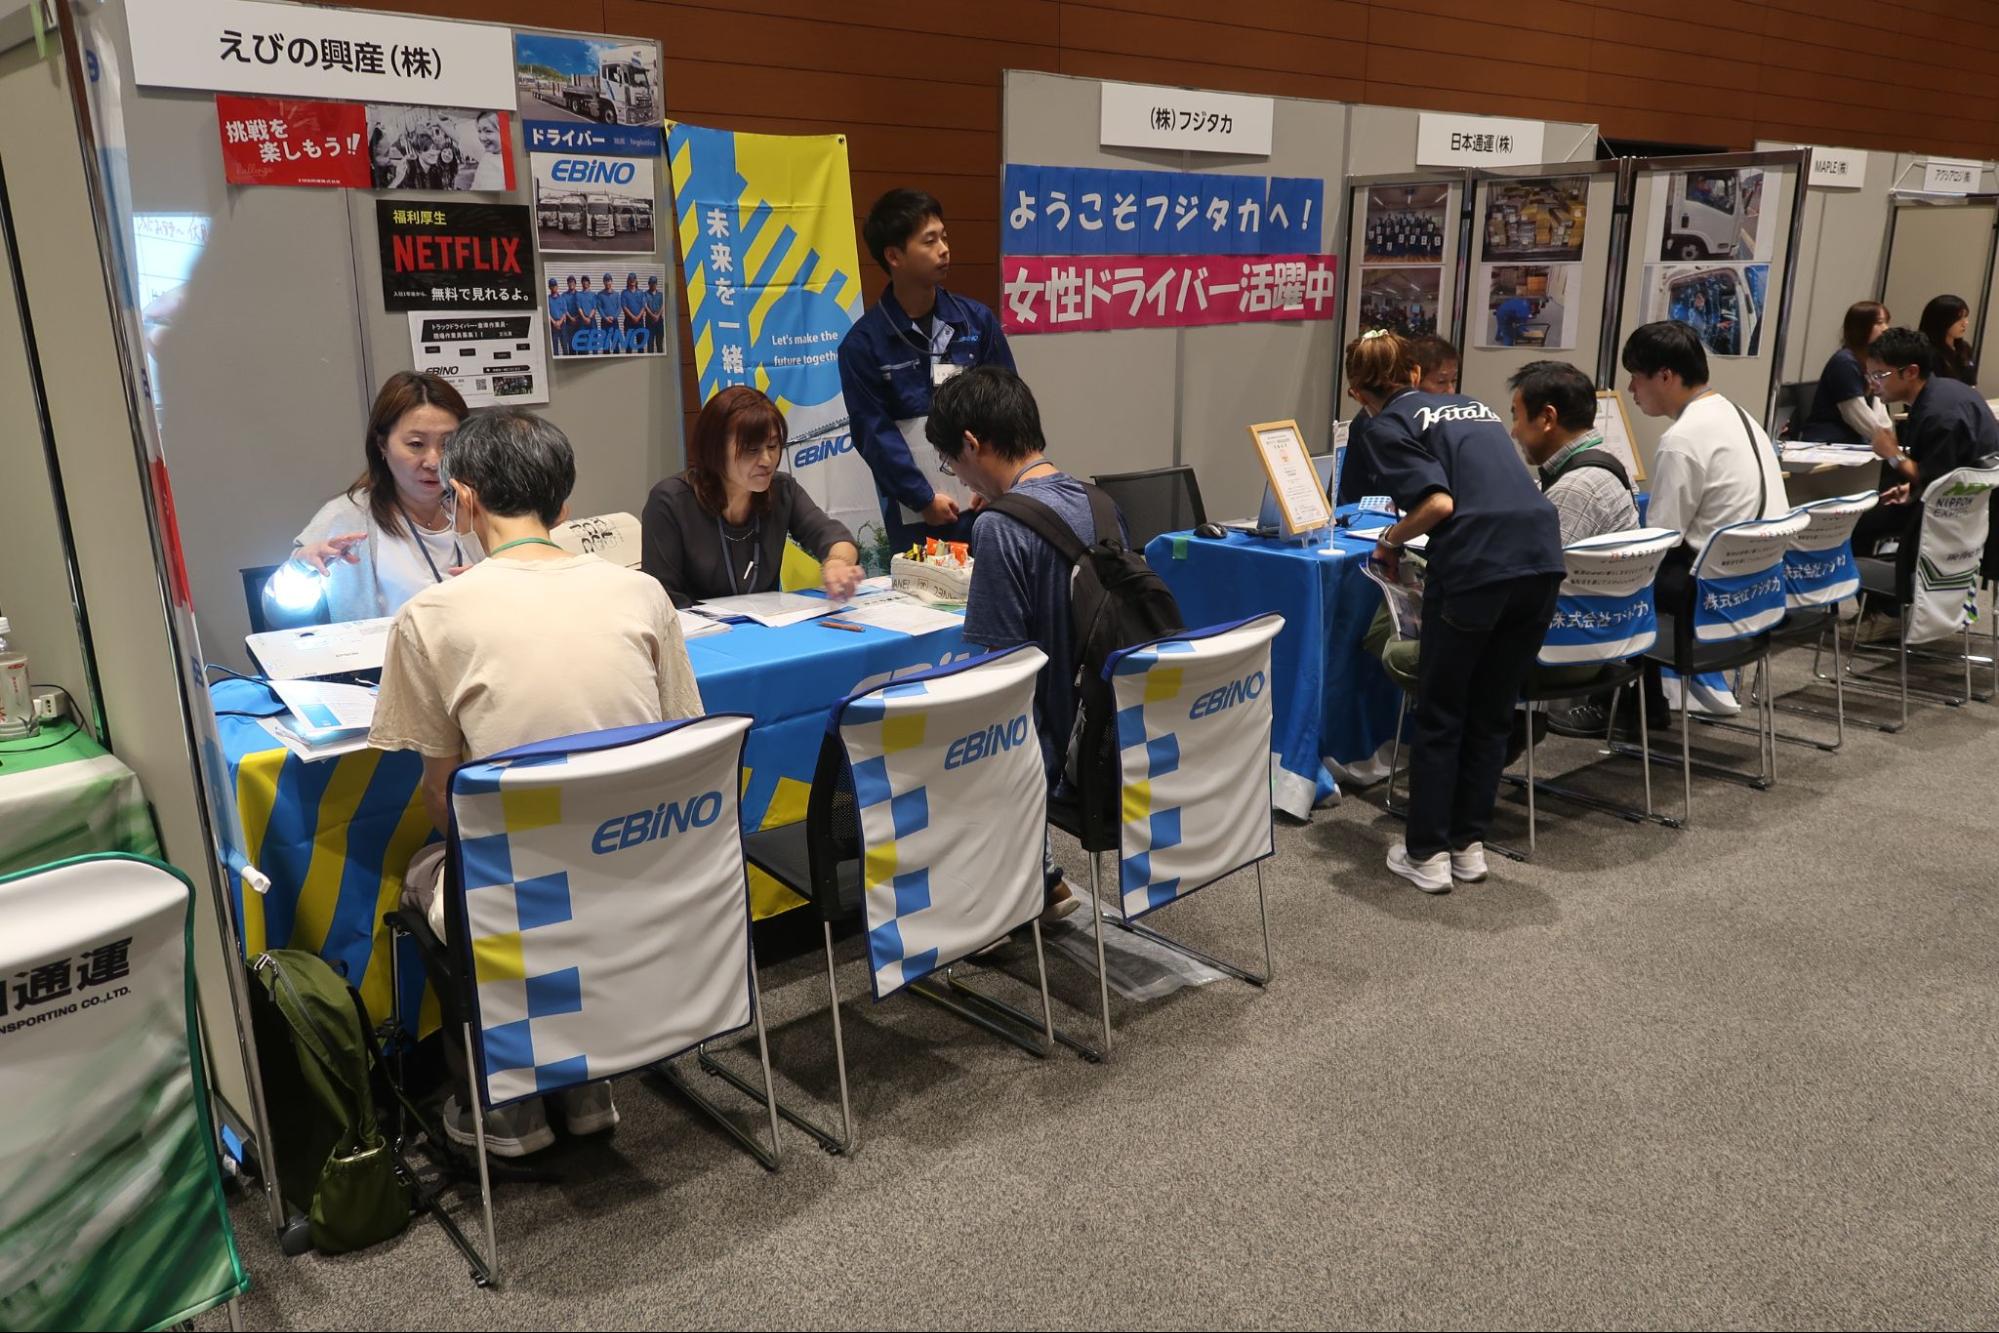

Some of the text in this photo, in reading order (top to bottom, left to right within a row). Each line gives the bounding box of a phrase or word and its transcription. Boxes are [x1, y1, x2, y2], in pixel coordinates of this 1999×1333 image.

[219, 30, 441, 79] えびの興産(株)
[225, 119, 289, 144] 挑戦を
[1151, 106, 1233, 134] (株)フジタカ
[532, 127, 606, 147] ドライバー
[1451, 132, 1514, 154] 日本通運(株)
[393, 209, 448, 226] 福利厚生
[1009, 190, 1313, 234] ようこそフジタカへ!
[392, 235, 523, 274] NETFLIX
[1004, 262, 1335, 325] 女性ドライバー活躍中
[772, 330, 839, 346] Let's make the
[774, 350, 838, 367] future togeth
[0, 936, 133, 1017] 通運
